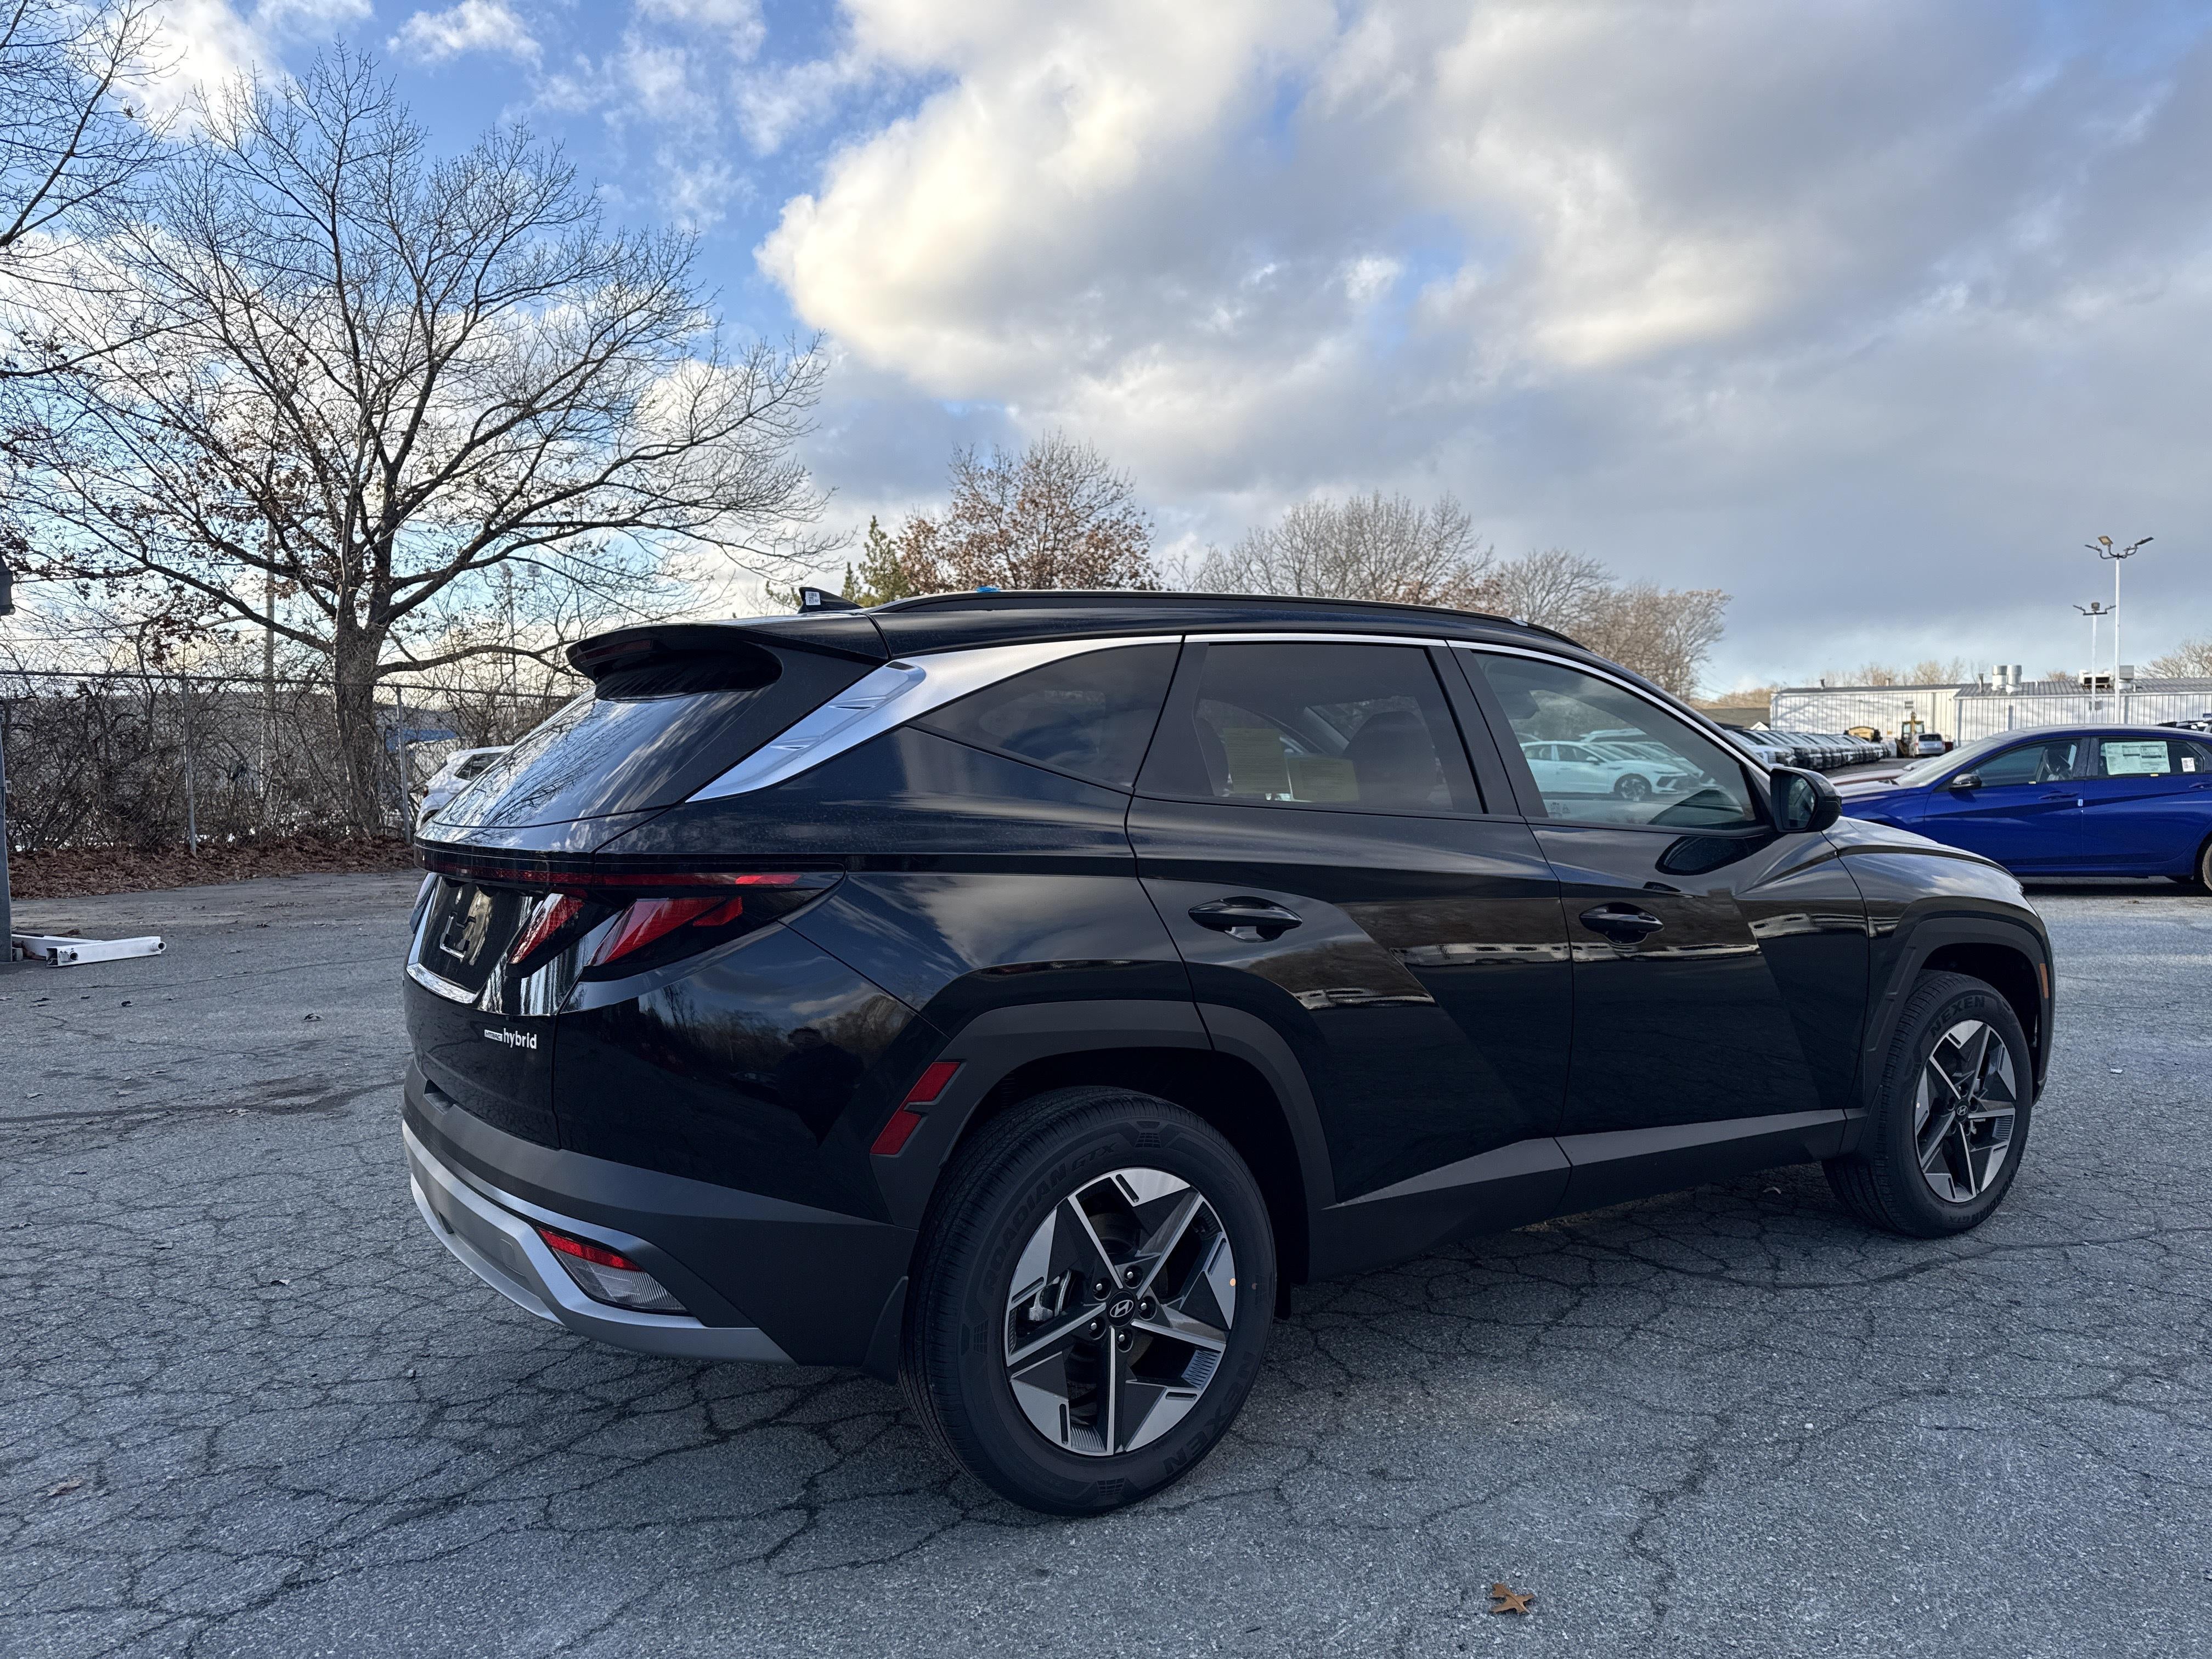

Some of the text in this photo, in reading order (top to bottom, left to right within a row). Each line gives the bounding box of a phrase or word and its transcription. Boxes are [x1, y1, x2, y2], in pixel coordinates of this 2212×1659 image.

[485, 1028, 537, 1049] HTRAC hybrid
[1929, 996, 1985, 1038] NEXEN
[982, 1142, 1116, 1293] ROADIAN GTX
[1163, 1351, 1257, 1474] NEXEN
